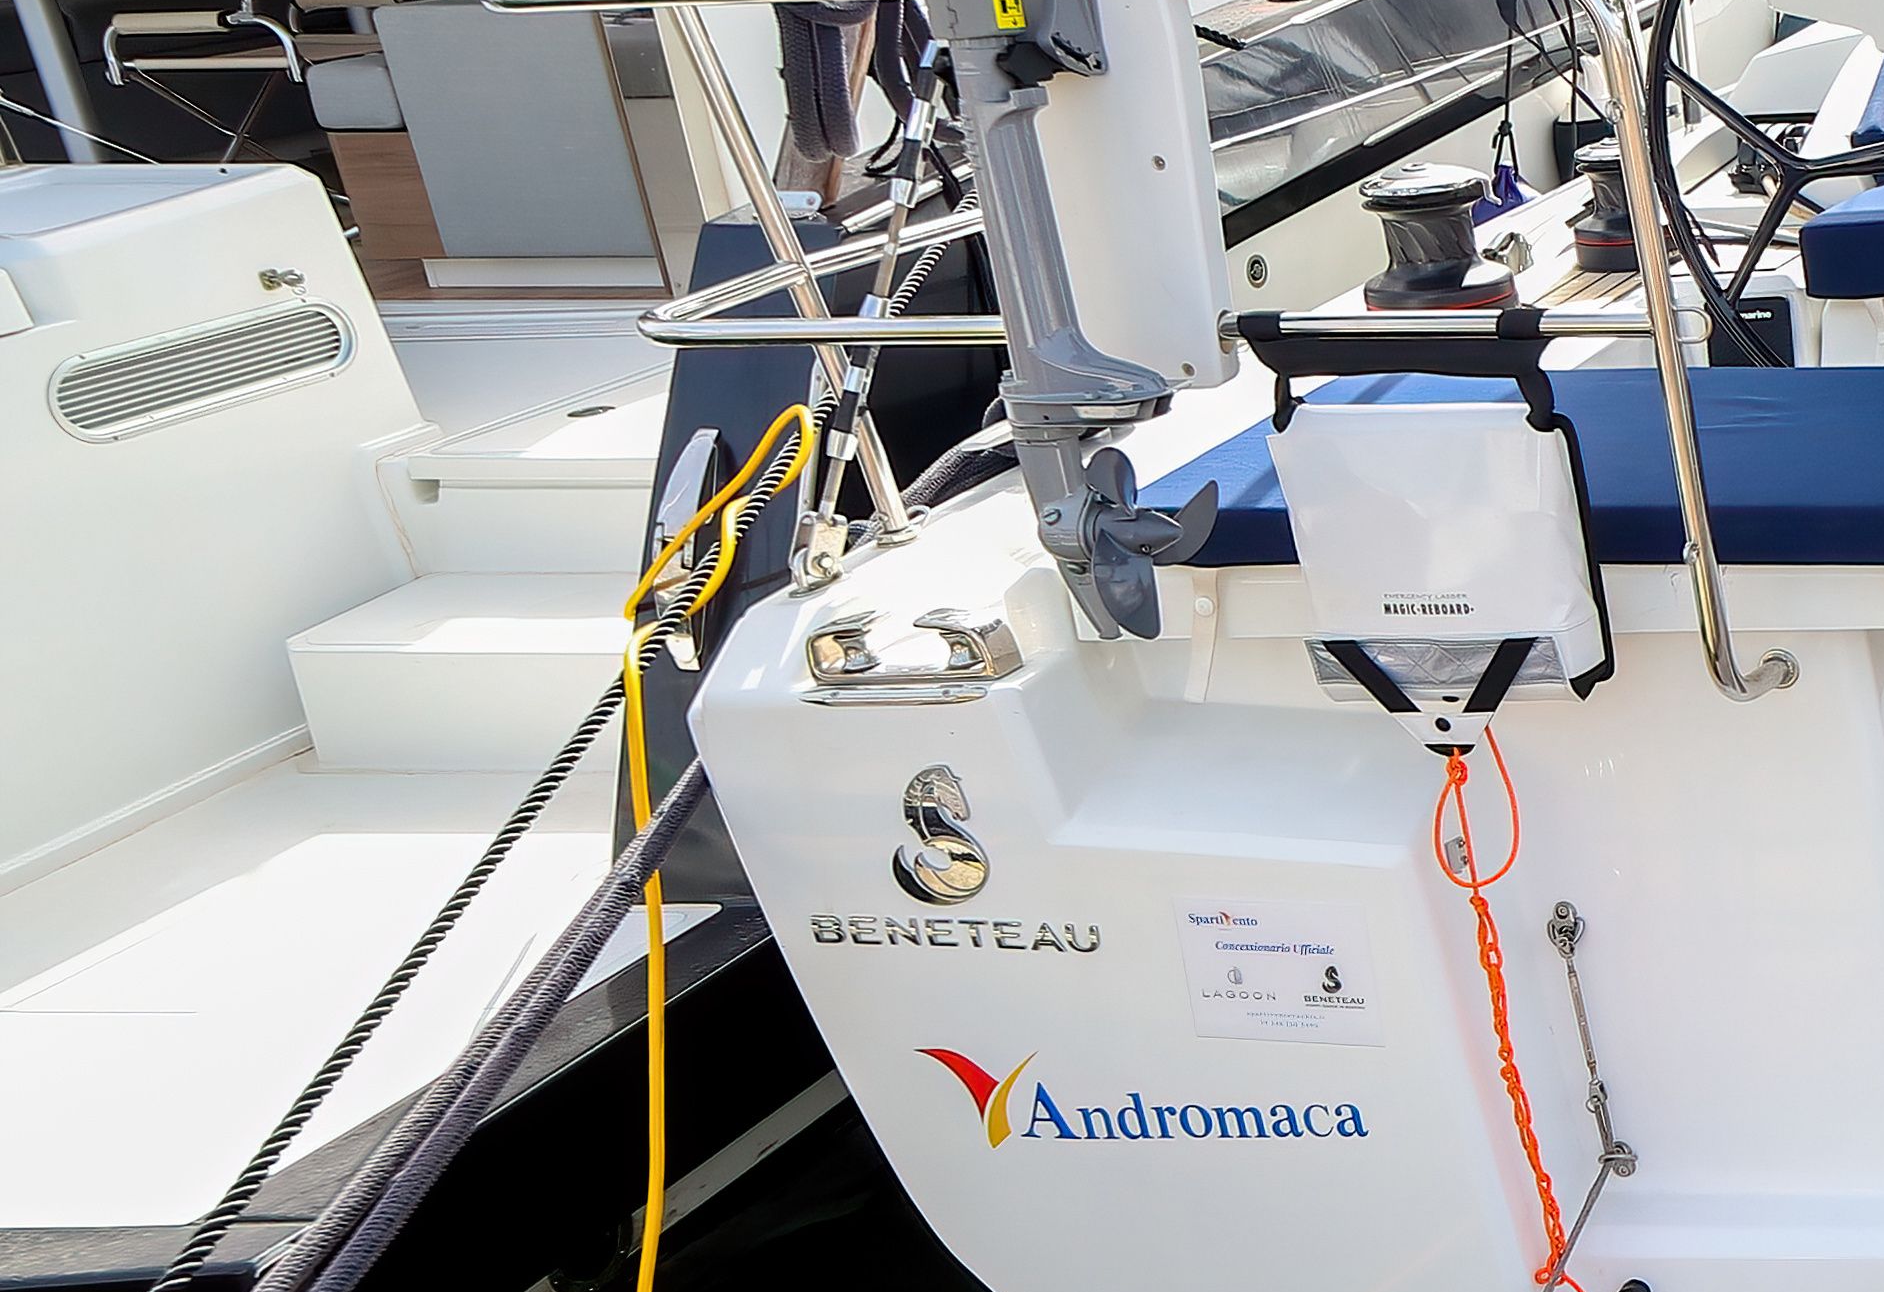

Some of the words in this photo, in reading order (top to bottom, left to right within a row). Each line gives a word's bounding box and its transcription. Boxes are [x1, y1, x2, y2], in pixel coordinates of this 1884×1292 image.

[810, 915, 1101, 954] BENETEAU
[1202, 989, 1277, 1002] LAGOON
[1304, 994, 1366, 1006] BENETEAU
[1020, 1081, 1370, 1141] Andromaca
